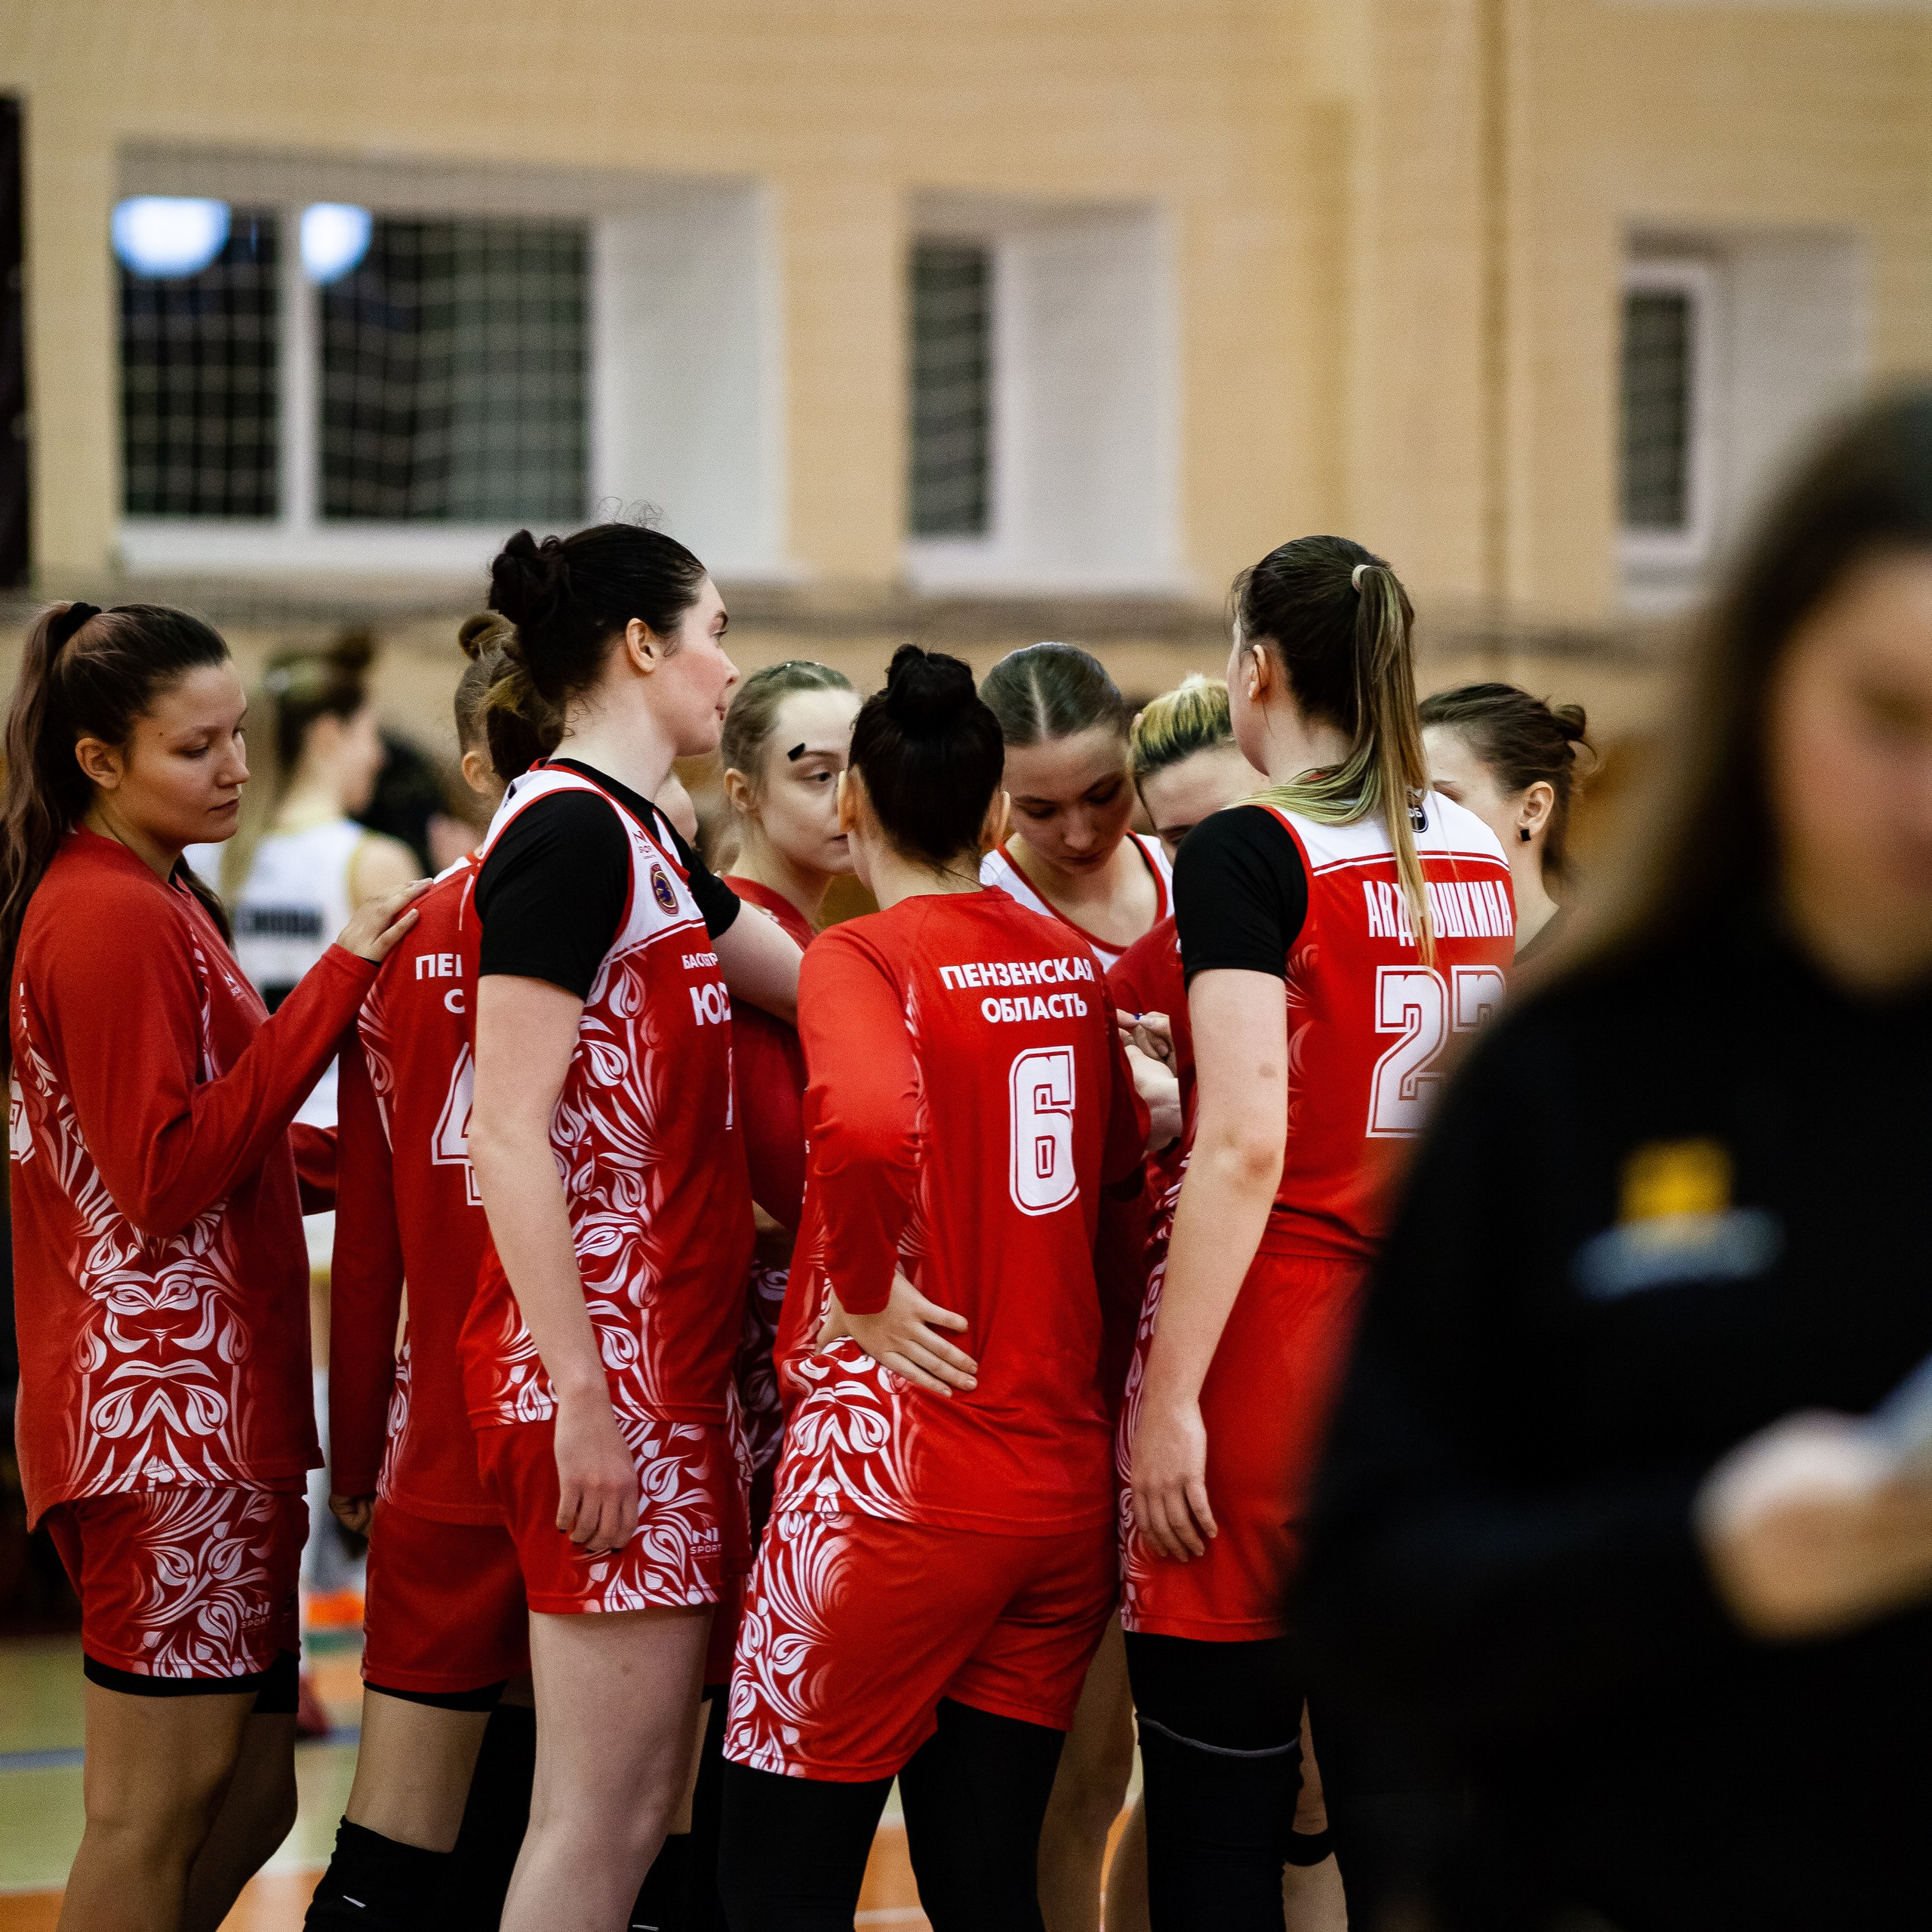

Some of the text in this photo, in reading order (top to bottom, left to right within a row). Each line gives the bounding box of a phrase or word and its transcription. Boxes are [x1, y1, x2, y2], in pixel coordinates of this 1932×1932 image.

[1362, 880, 1513, 946] АНДЮШКИНА
[940, 957, 1094, 989] ПЕНЗЕНСКАЯ
[981, 993, 1088, 1023] ОБЛАСТЬ
[1008, 1045, 1080, 1216] 6
[690, 1544, 721, 1555] SPORT
[241, 1616, 270, 1629] SPORT
